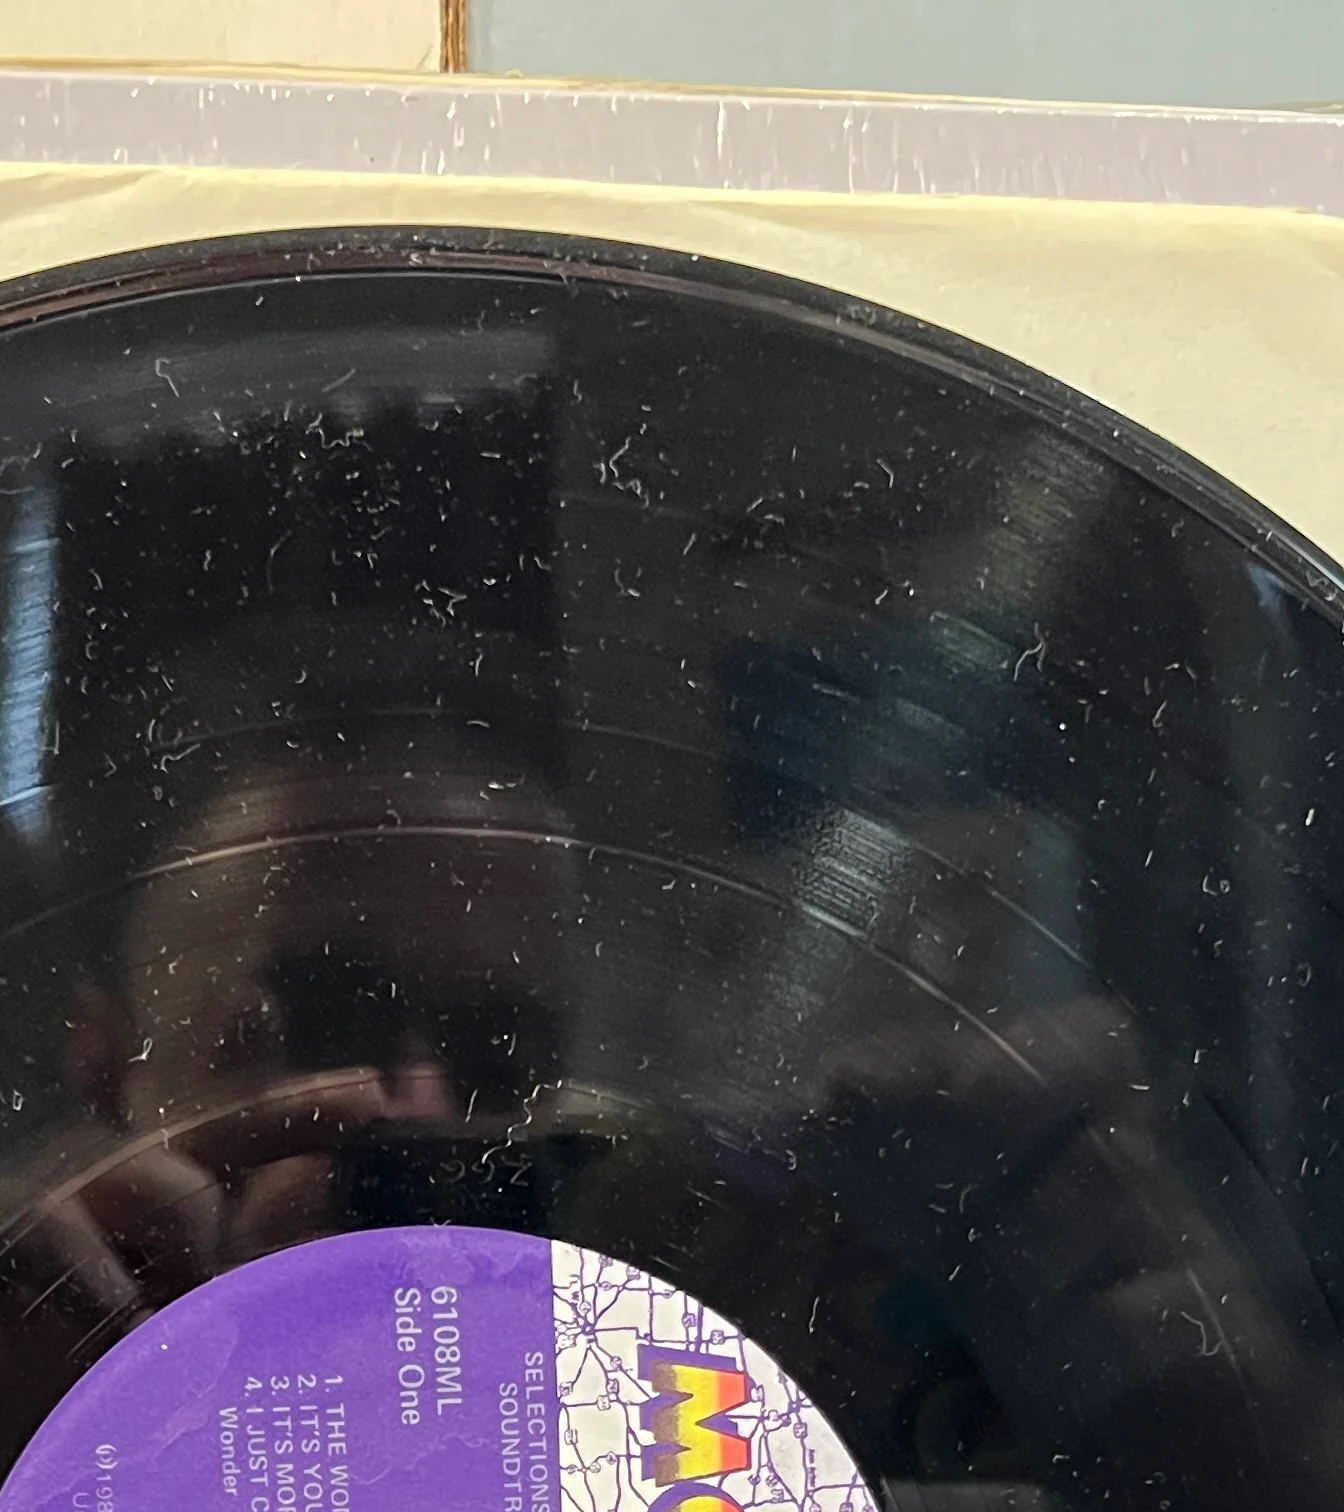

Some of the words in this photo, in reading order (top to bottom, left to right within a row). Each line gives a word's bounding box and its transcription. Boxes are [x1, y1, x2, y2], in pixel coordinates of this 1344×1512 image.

[394, 1288, 421, 1352] Side
[431, 1286, 462, 1416] 6108ML
[244, 1376, 263, 1396] 4.
[271, 1376, 289, 1396] 3.
[297, 1374, 316, 1394] 2.
[325, 1375, 343, 1392] 1.
[398, 1364, 424, 1425] One
[219, 1408, 240, 1495] Wonder
[272, 1407, 294, 1454] IT'S
[300, 1406, 320, 1453] IT'S
[326, 1403, 346, 1456] THE
[246, 1424, 268, 1486] JUST
